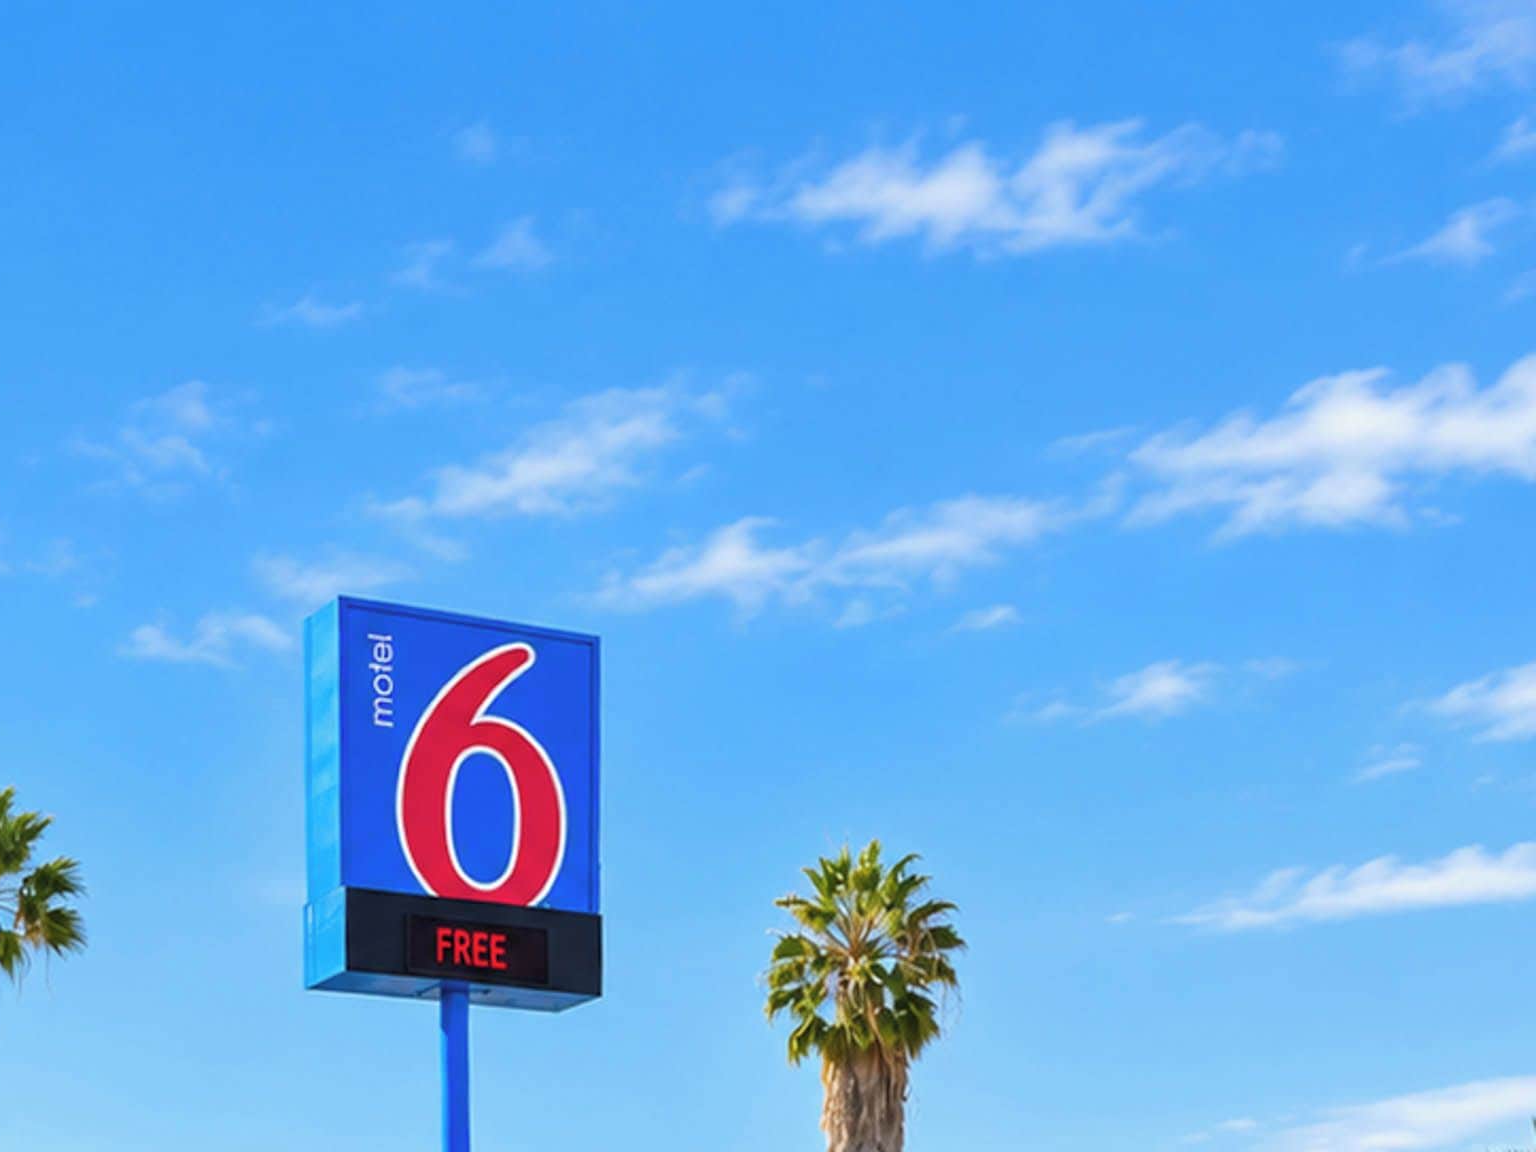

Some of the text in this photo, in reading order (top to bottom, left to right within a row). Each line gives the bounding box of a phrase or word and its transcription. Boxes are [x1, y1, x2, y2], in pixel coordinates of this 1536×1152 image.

[367, 632, 394, 728] motel
[396, 641, 567, 907] 6
[436, 926, 509, 970] FREE
